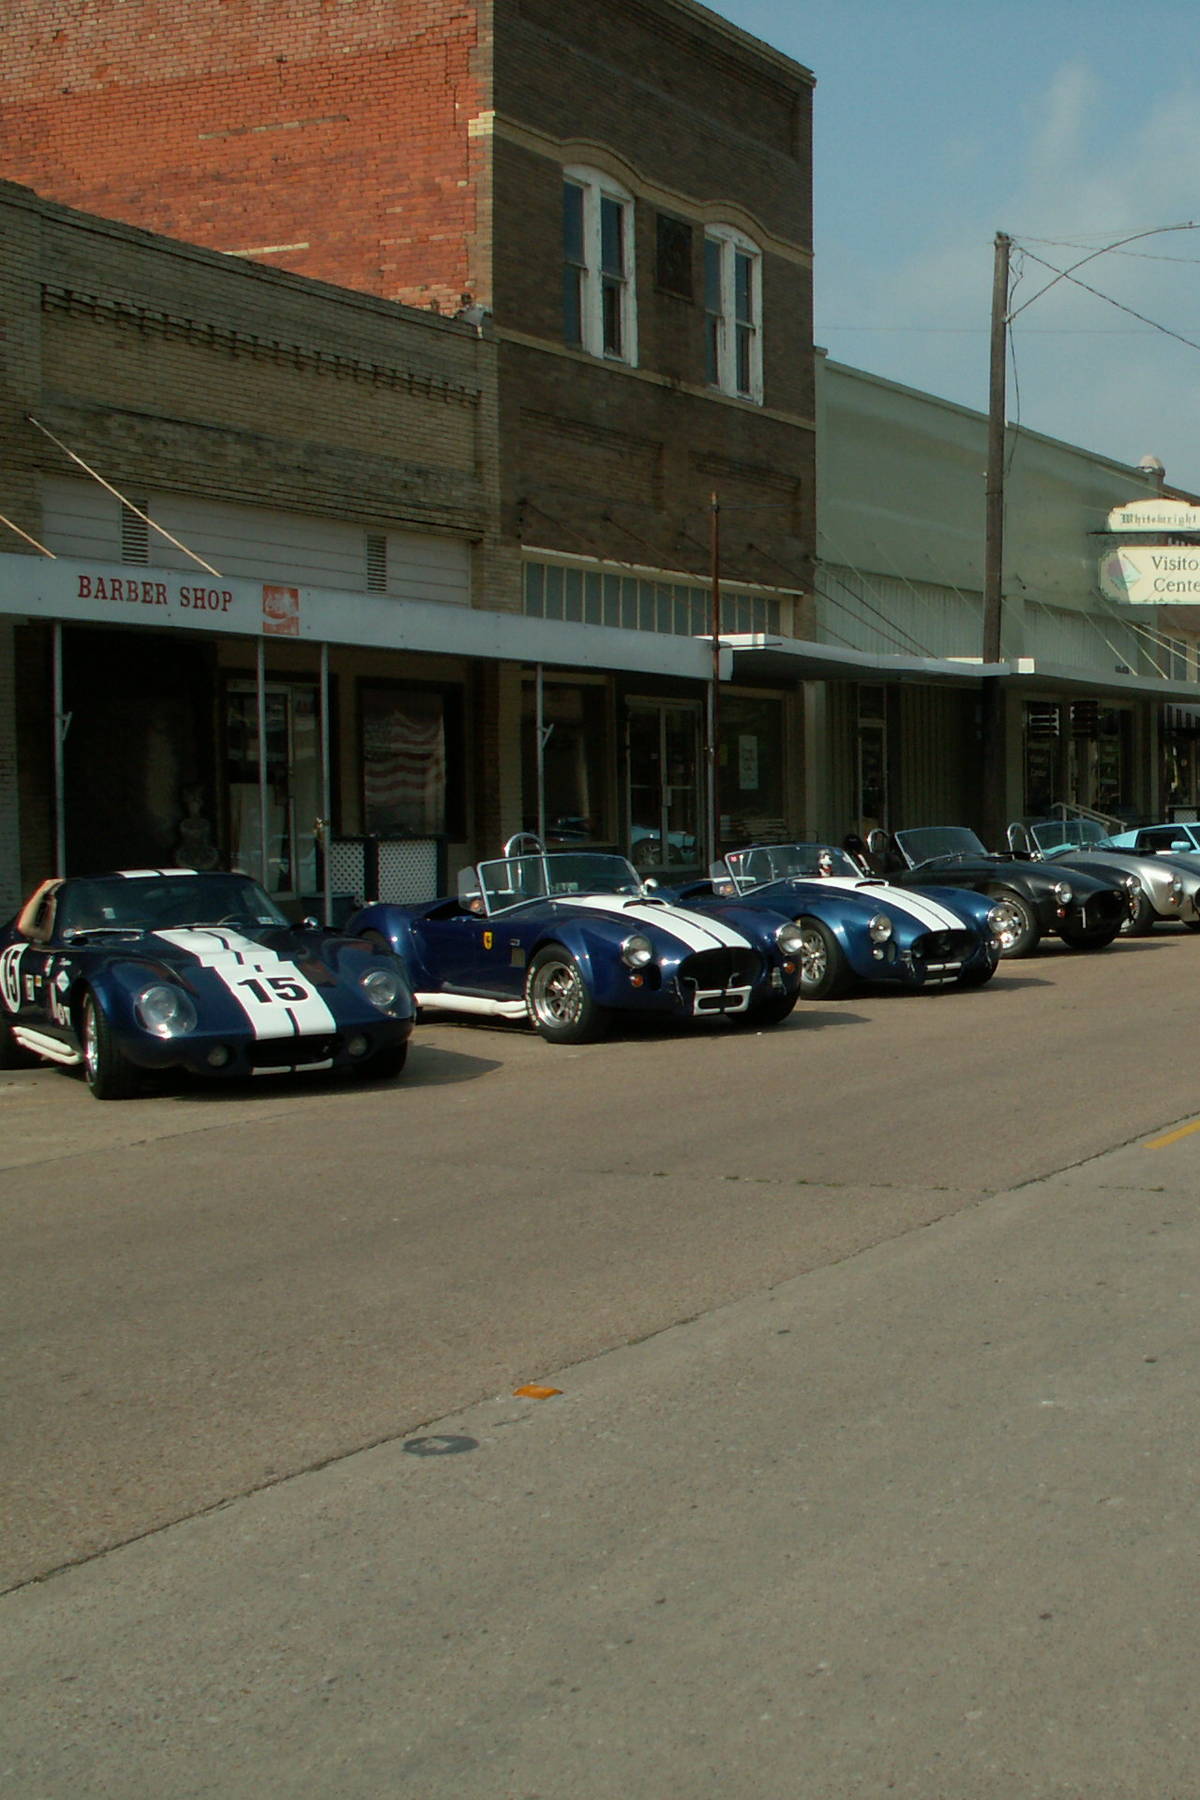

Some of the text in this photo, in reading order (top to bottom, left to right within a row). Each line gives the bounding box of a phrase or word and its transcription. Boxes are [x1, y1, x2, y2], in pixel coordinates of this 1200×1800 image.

[78, 575, 168, 605] BARBER
[180, 586, 233, 612] SHOP
[237, 977, 309, 1003] 15
